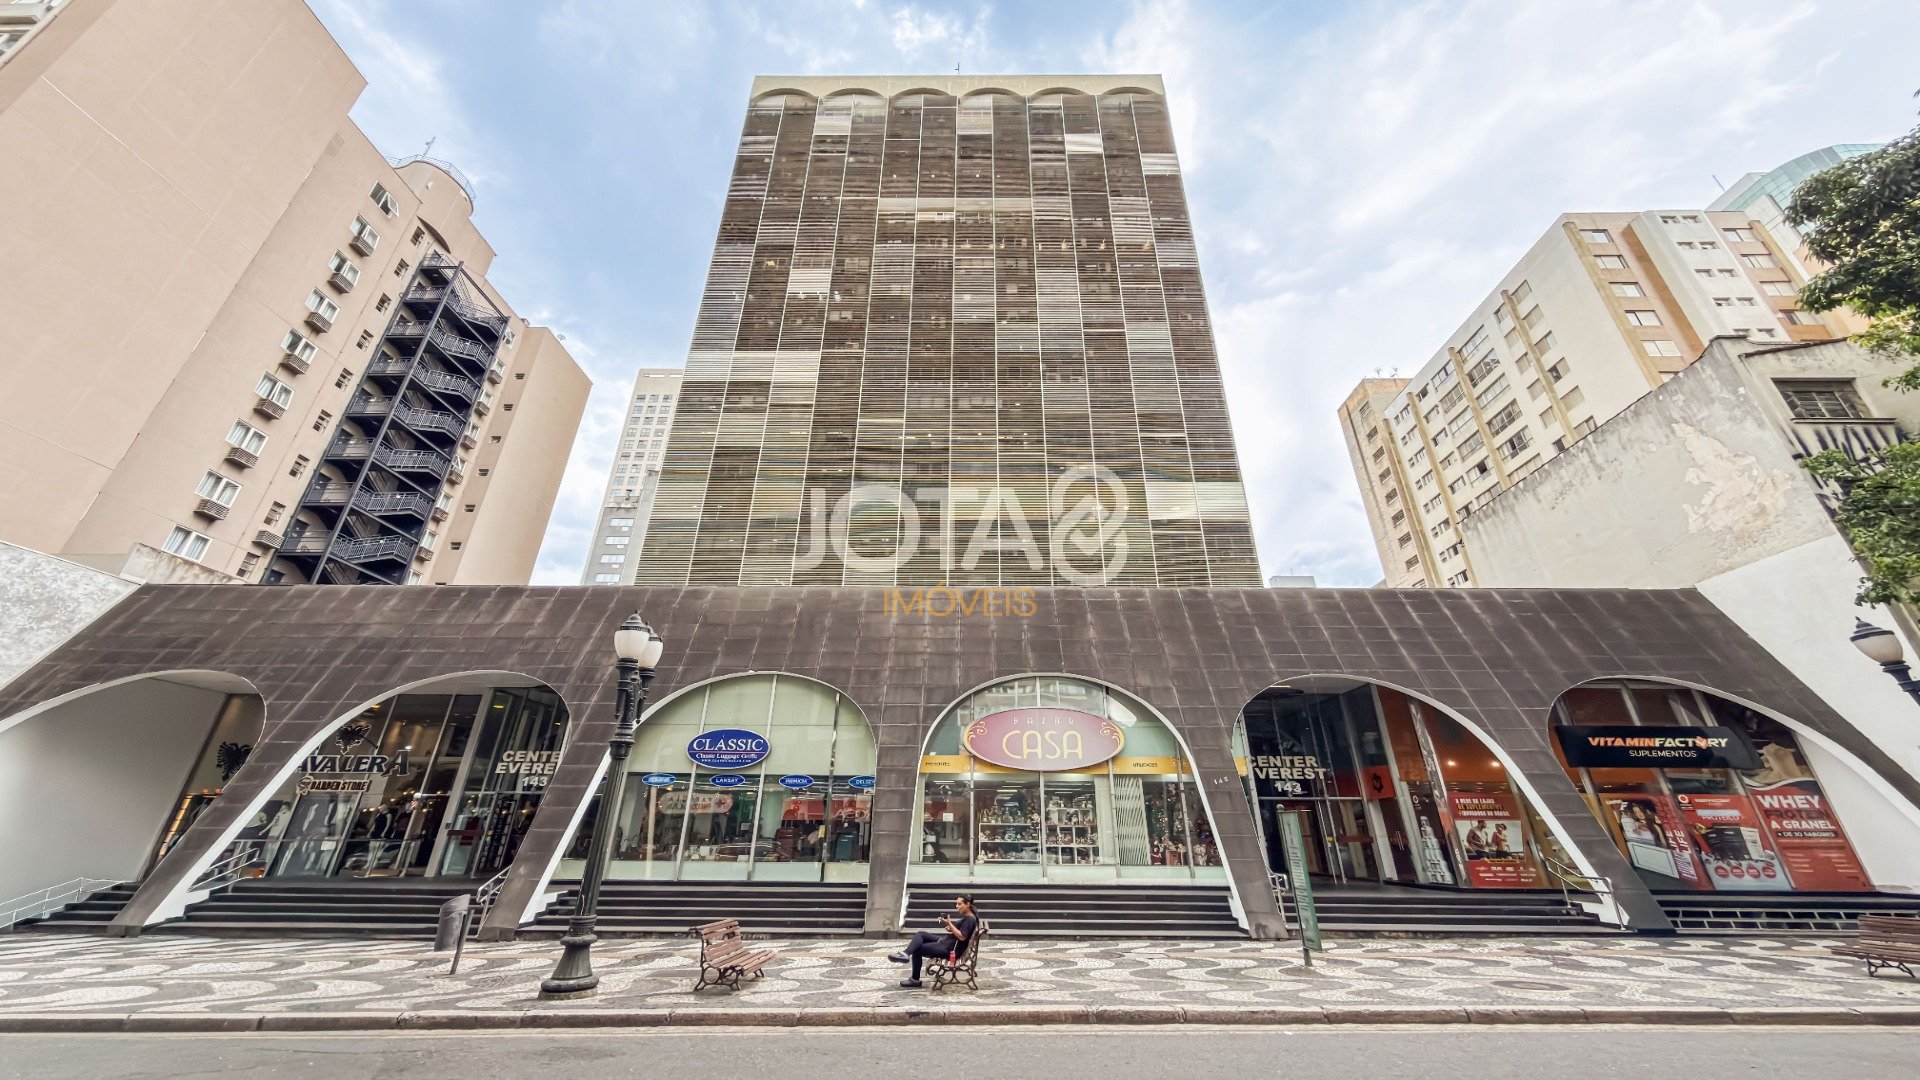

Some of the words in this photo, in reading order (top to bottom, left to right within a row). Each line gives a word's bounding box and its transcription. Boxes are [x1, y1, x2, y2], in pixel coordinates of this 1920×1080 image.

[1013, 717, 1074, 725] BAZAR
[692, 739, 764, 751] CLASSIC
[1002, 730, 1083, 760] CASA
[1588, 736, 1728, 748] VITAMINFACTORY
[1629, 750, 1697, 758] SUPLEMENTOS
[522, 776, 548, 786] 143
[1274, 782, 1302, 794] 143
[1756, 795, 1820, 808] WHEY
[1763, 809, 1830, 819] PROTEIN
[1771, 820, 1781, 829] A
[1782, 820, 1837, 829] GRANEL
